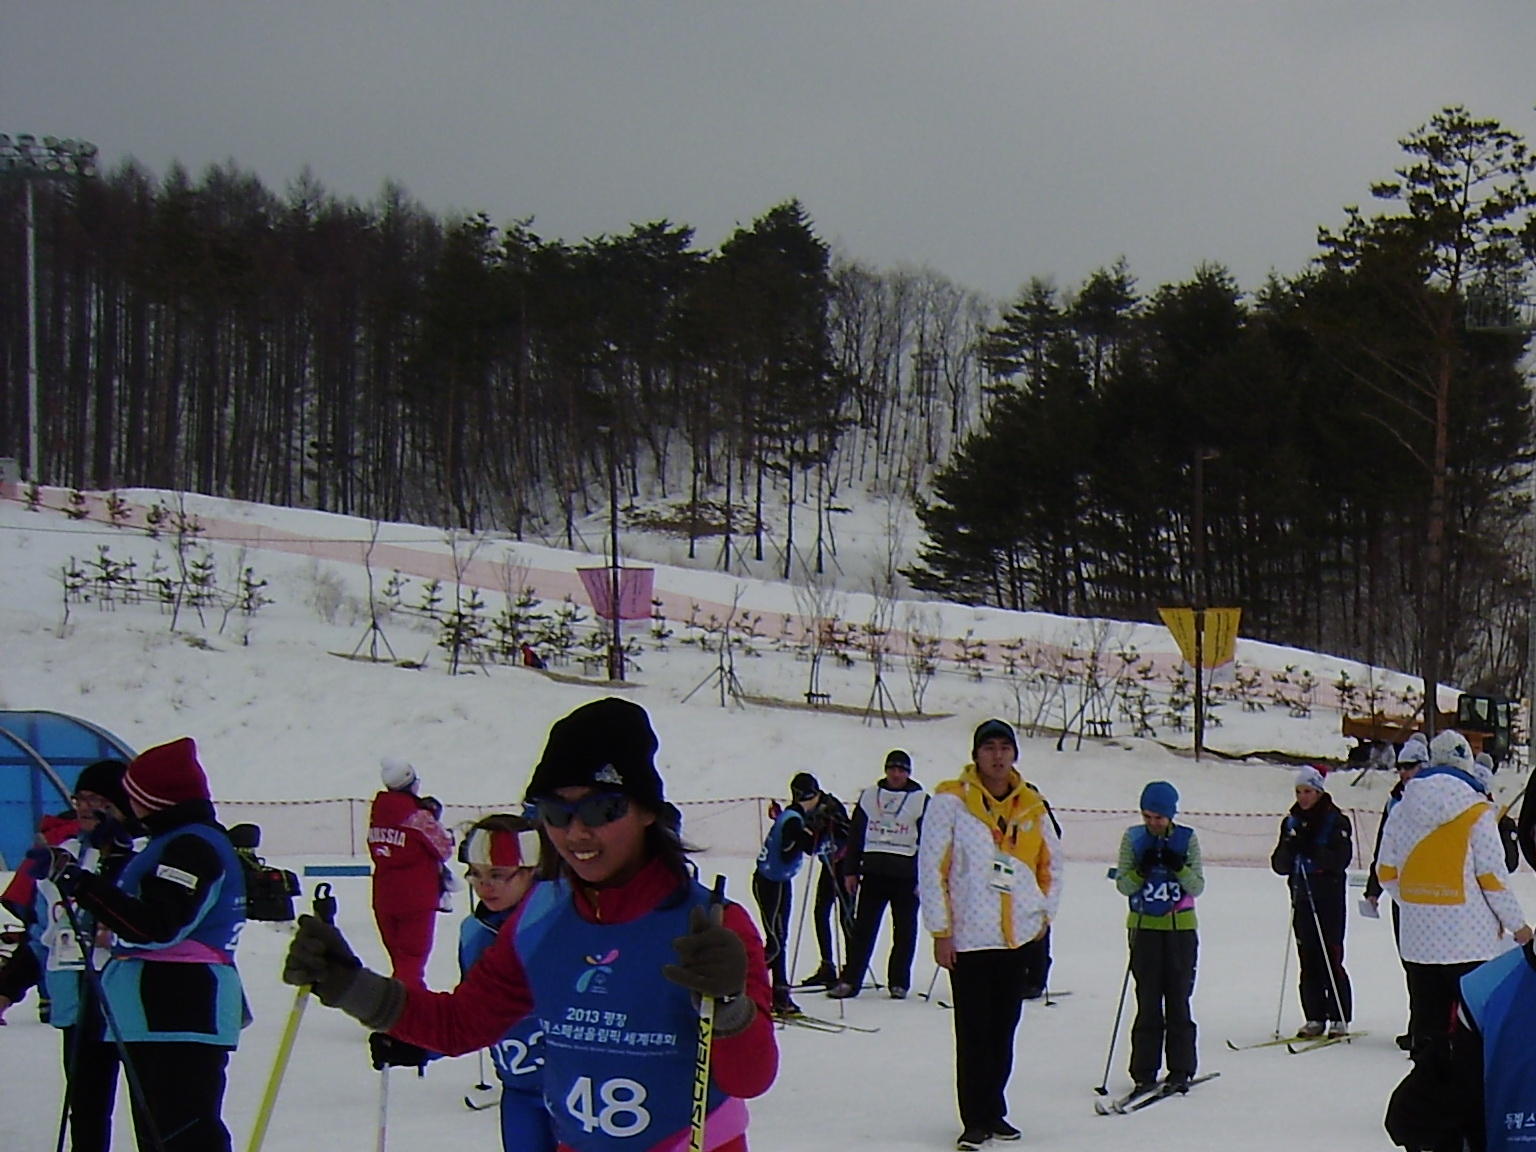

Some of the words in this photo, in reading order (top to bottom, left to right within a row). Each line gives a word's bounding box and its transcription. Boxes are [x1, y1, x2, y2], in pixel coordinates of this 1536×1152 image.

[1143, 881, 1181, 902] 243
[566, 1007, 600, 1023] 2013
[603, 1011, 627, 1027] 평창
[566, 1076, 651, 1137] 48
